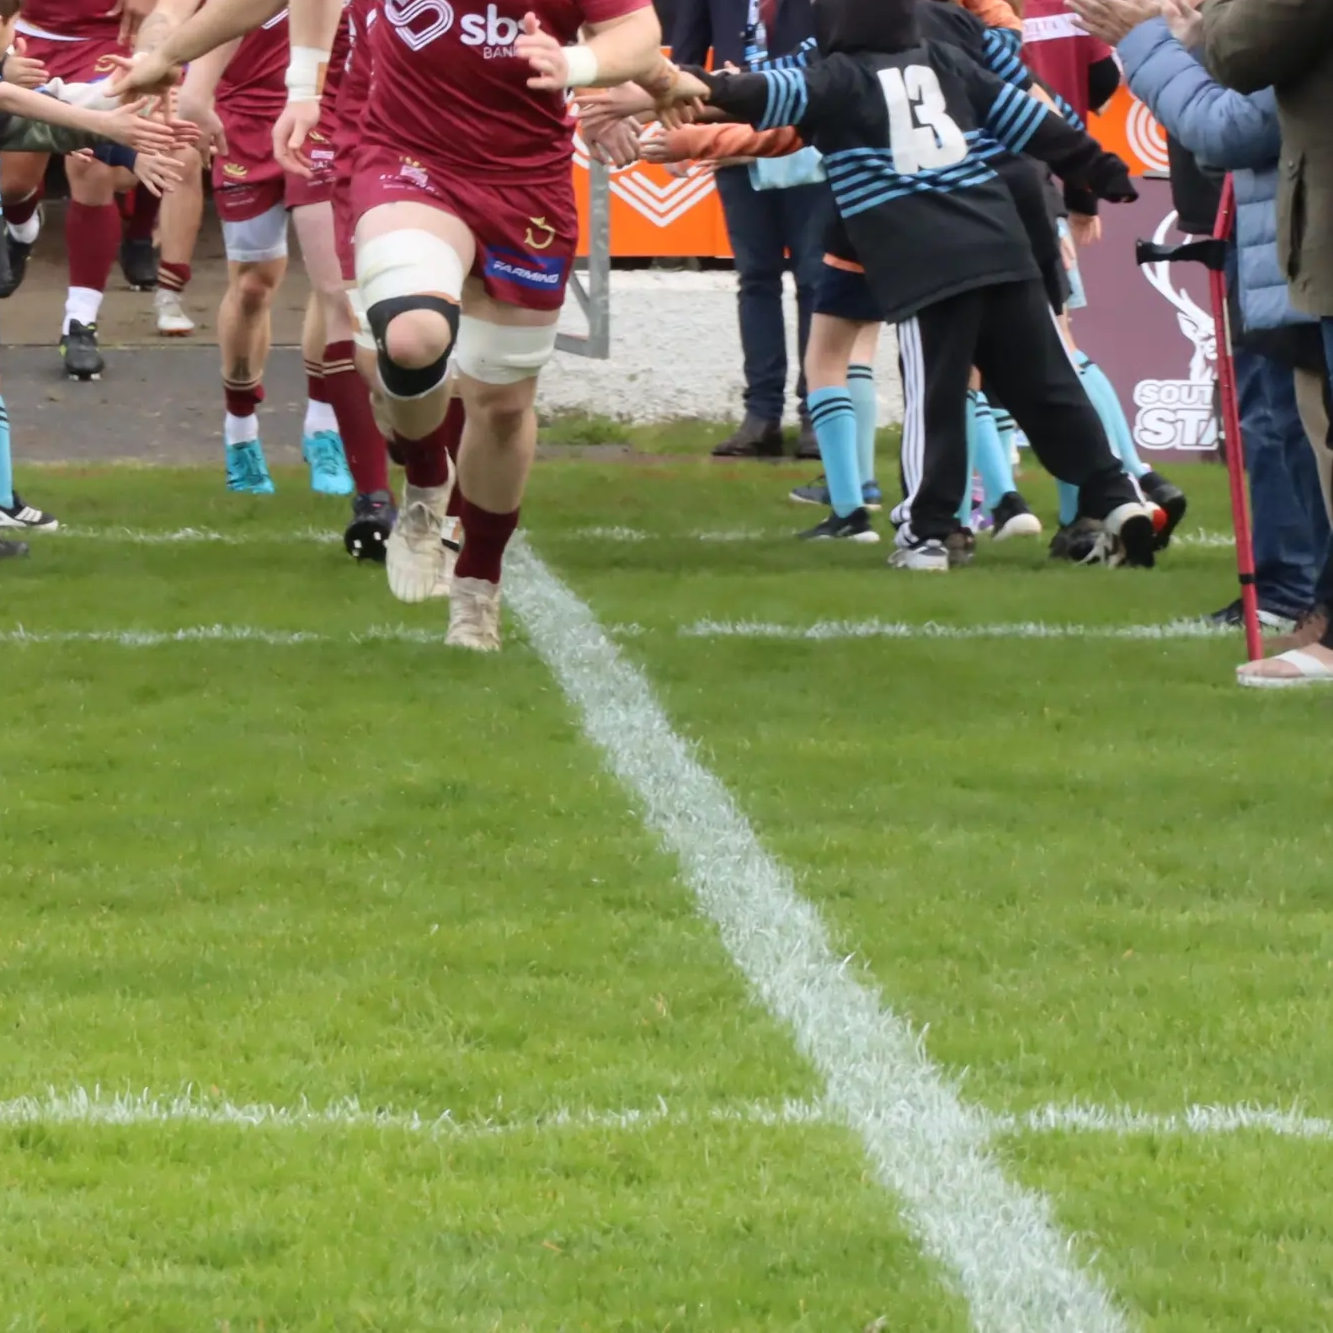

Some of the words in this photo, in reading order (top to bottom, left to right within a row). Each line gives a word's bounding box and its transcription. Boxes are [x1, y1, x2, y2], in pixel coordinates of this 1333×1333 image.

[482, 45, 517, 60] BAN
[876, 64, 968, 175] 13
[493, 260, 560, 284] FARMING
